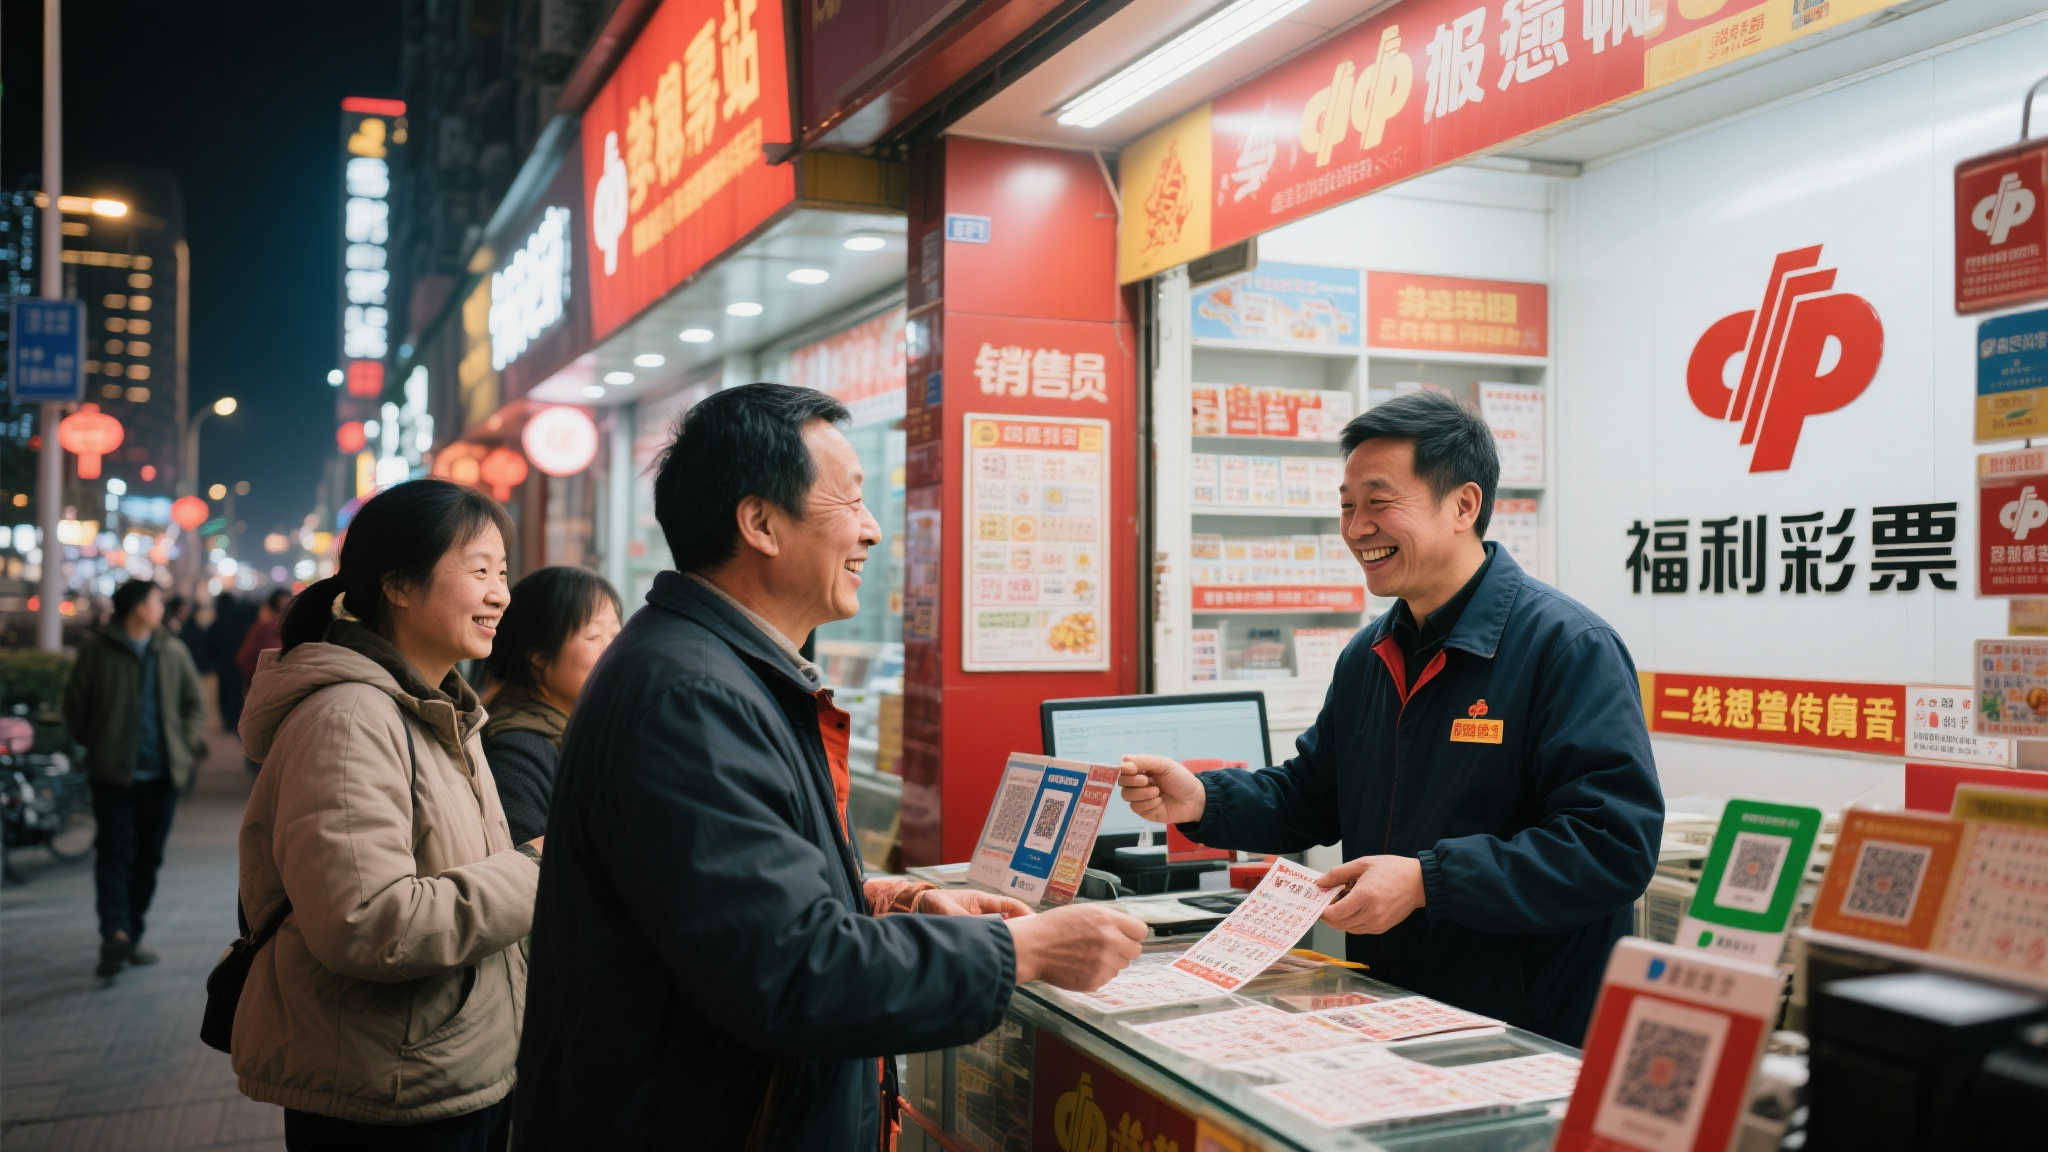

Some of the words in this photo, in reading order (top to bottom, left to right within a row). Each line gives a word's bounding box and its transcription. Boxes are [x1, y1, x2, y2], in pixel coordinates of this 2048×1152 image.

[974, 343, 1108, 403] 销售员
[1626, 502, 1958, 594] 福利彩票
